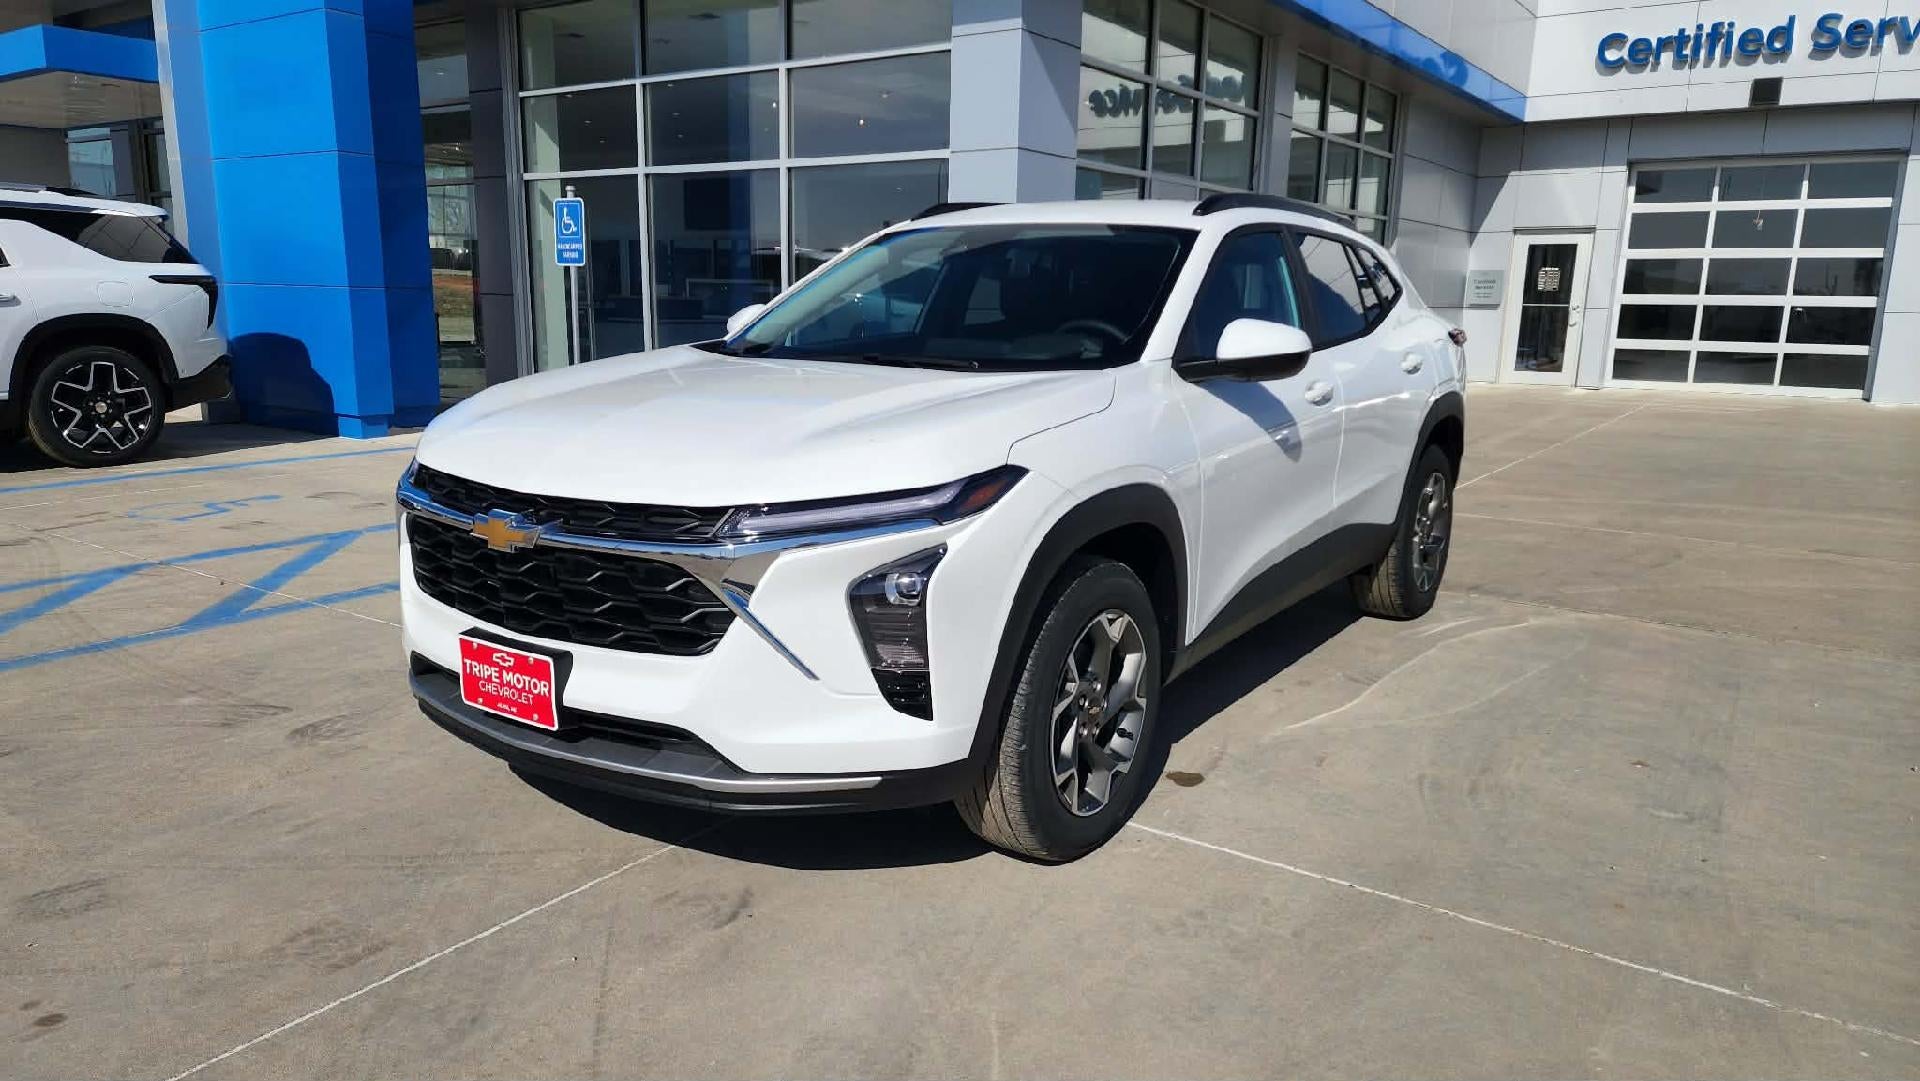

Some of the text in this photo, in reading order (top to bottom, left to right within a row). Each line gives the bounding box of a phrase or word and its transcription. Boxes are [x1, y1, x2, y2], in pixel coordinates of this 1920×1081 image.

[1598, 14, 1796, 68] Certified
[463, 658, 550, 697] TRIPE MOTOR
[478, 680, 534, 705] CHEVROLET
